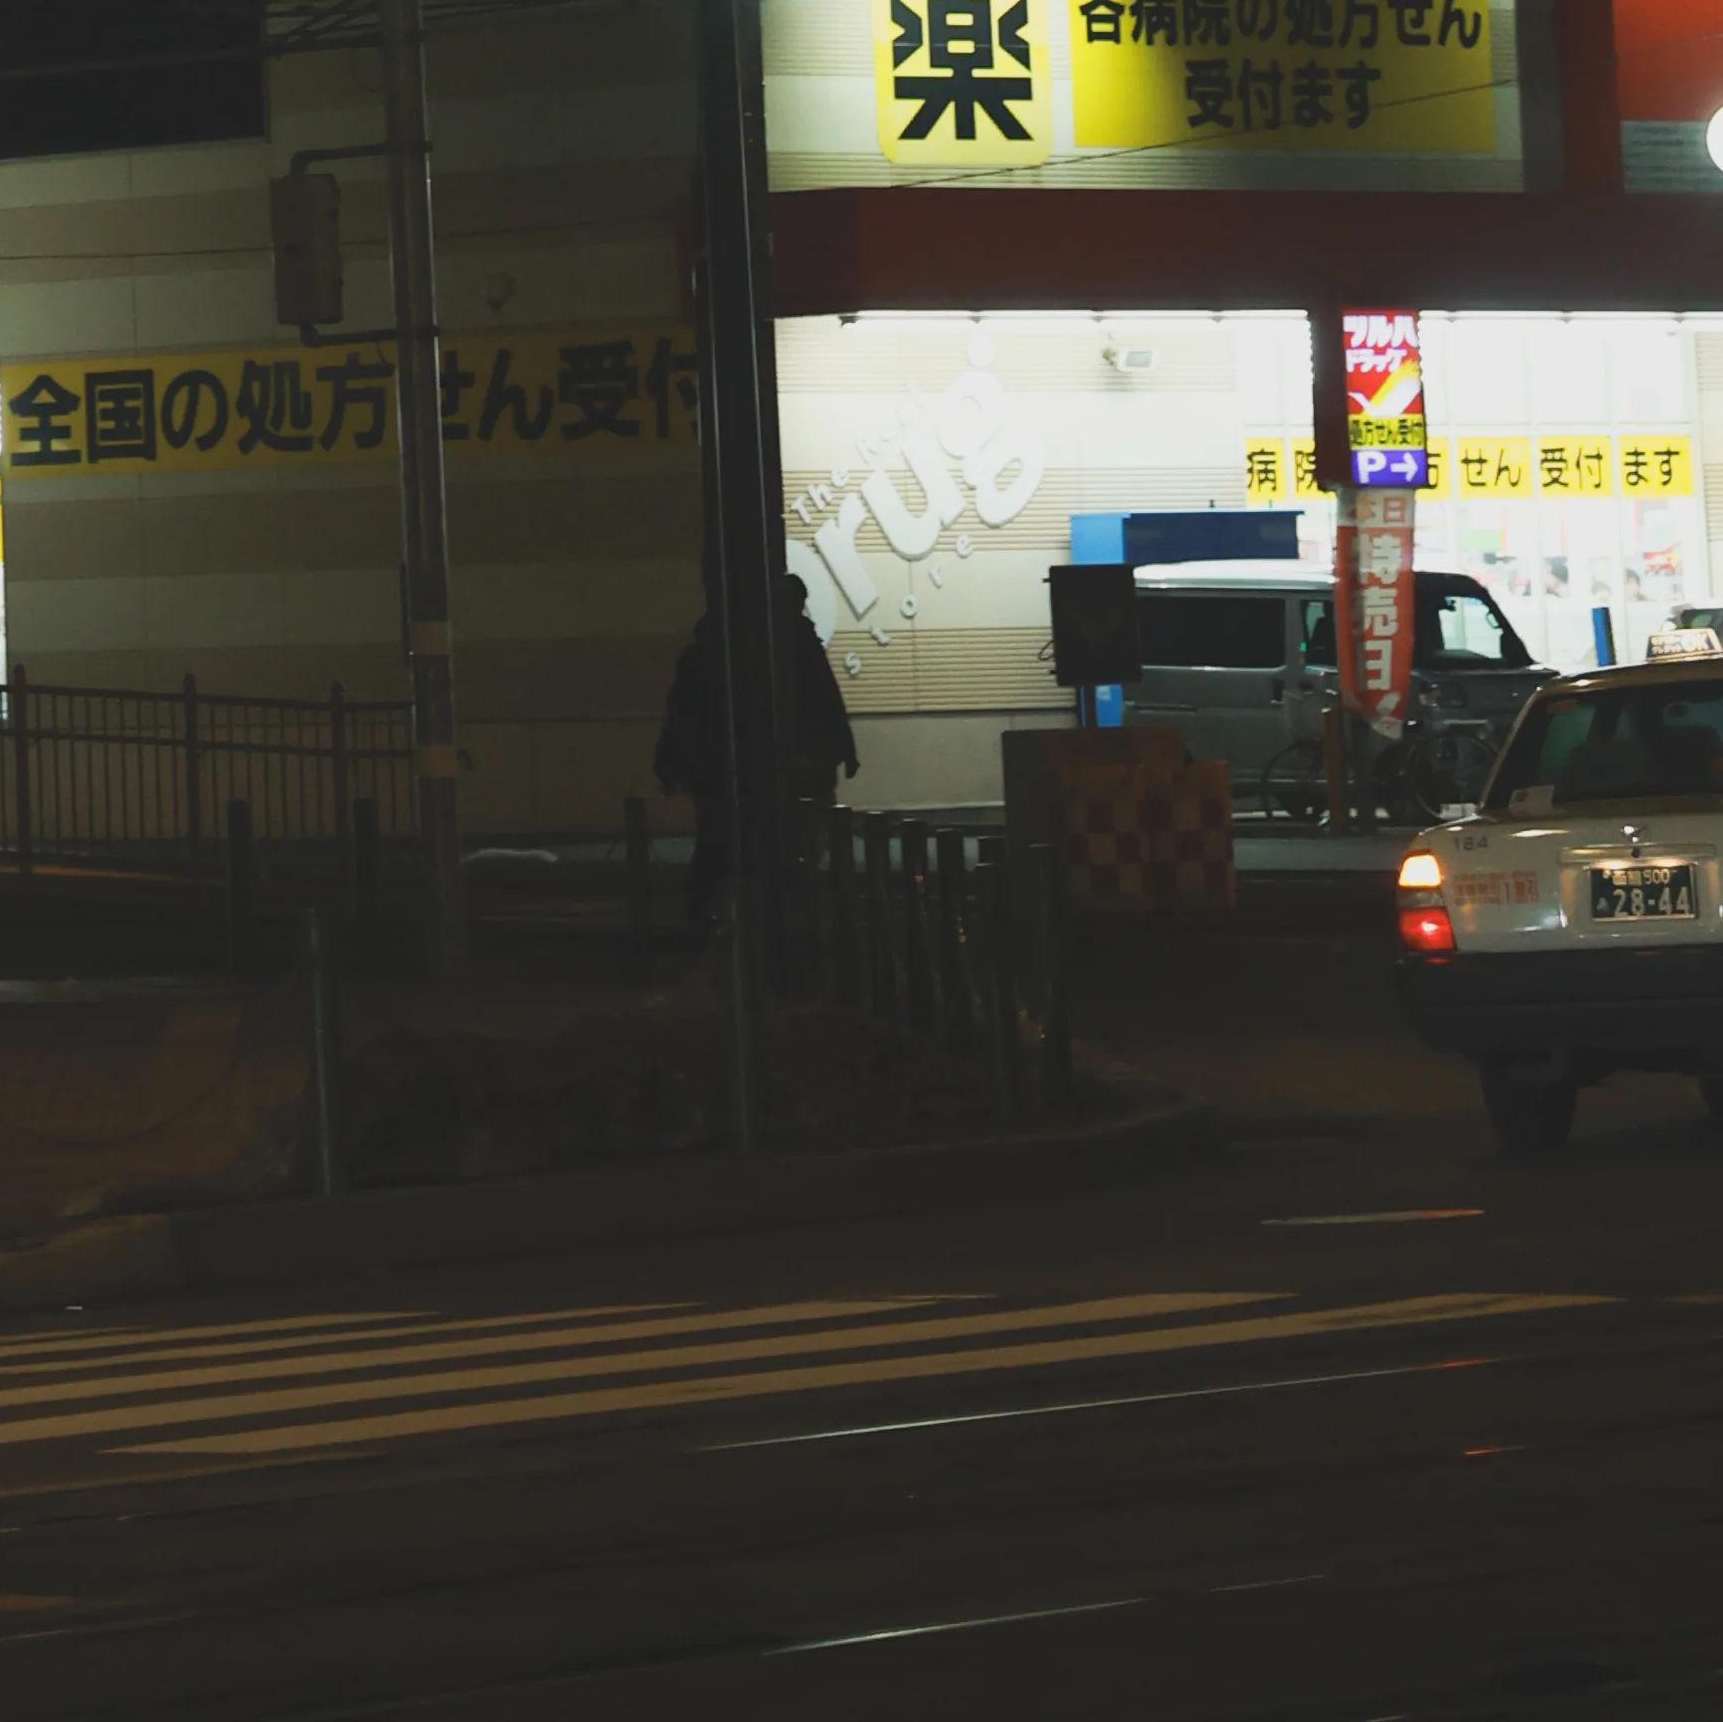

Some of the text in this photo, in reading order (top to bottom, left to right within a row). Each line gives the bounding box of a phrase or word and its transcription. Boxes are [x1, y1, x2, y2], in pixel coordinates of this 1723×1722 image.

[1183, 58, 1383, 131] 受付ます
[1343, 315, 1419, 348] ツルハ
[1345, 348, 1408, 374] ドラッグ
[1357, 451, 1387, 485] P
[1614, 886, 1690, 917] 28-44
